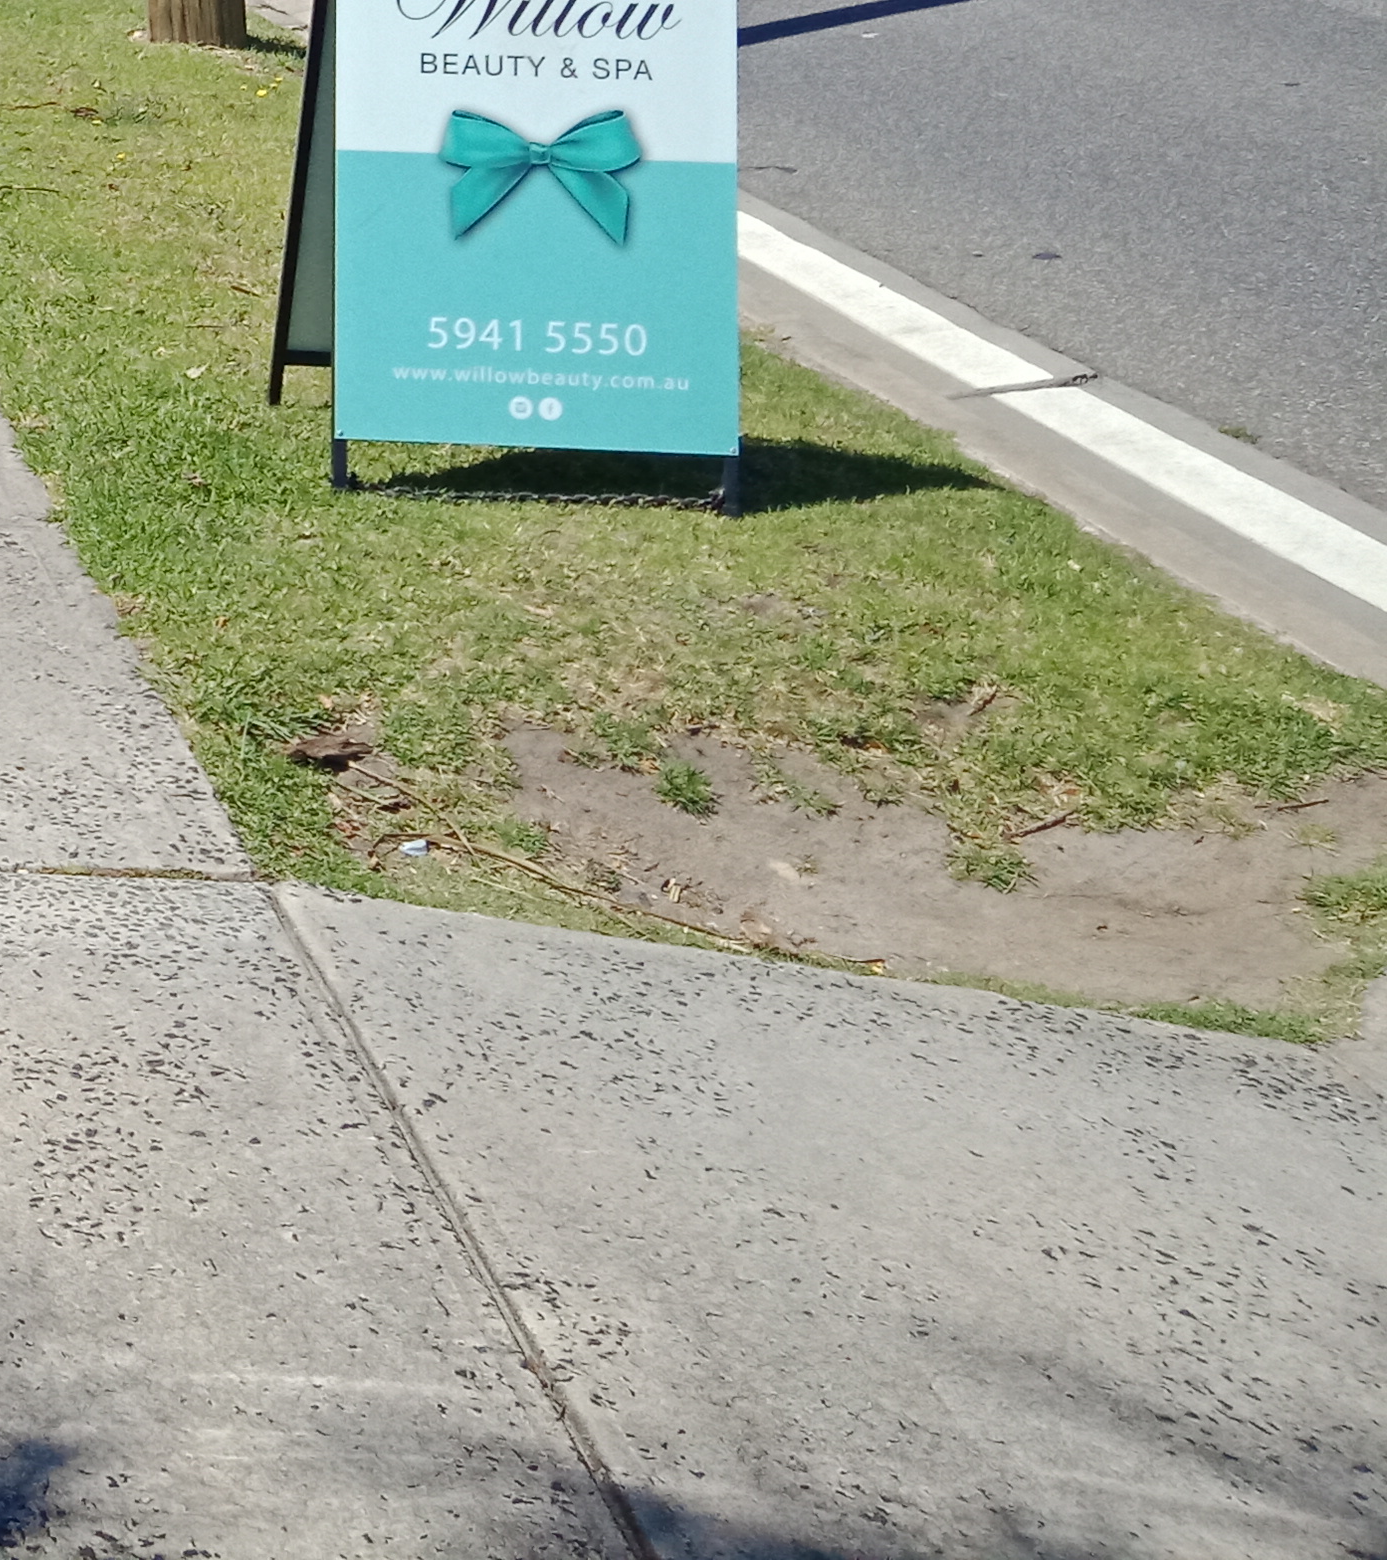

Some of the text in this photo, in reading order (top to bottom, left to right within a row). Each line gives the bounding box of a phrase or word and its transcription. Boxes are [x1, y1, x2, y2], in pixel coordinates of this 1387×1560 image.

[420, 52, 654, 81] BEAUTY & SPA
[428, 317, 648, 356] 5941 5550
[393, 366, 689, 391] www.willowbeauty.com.au
